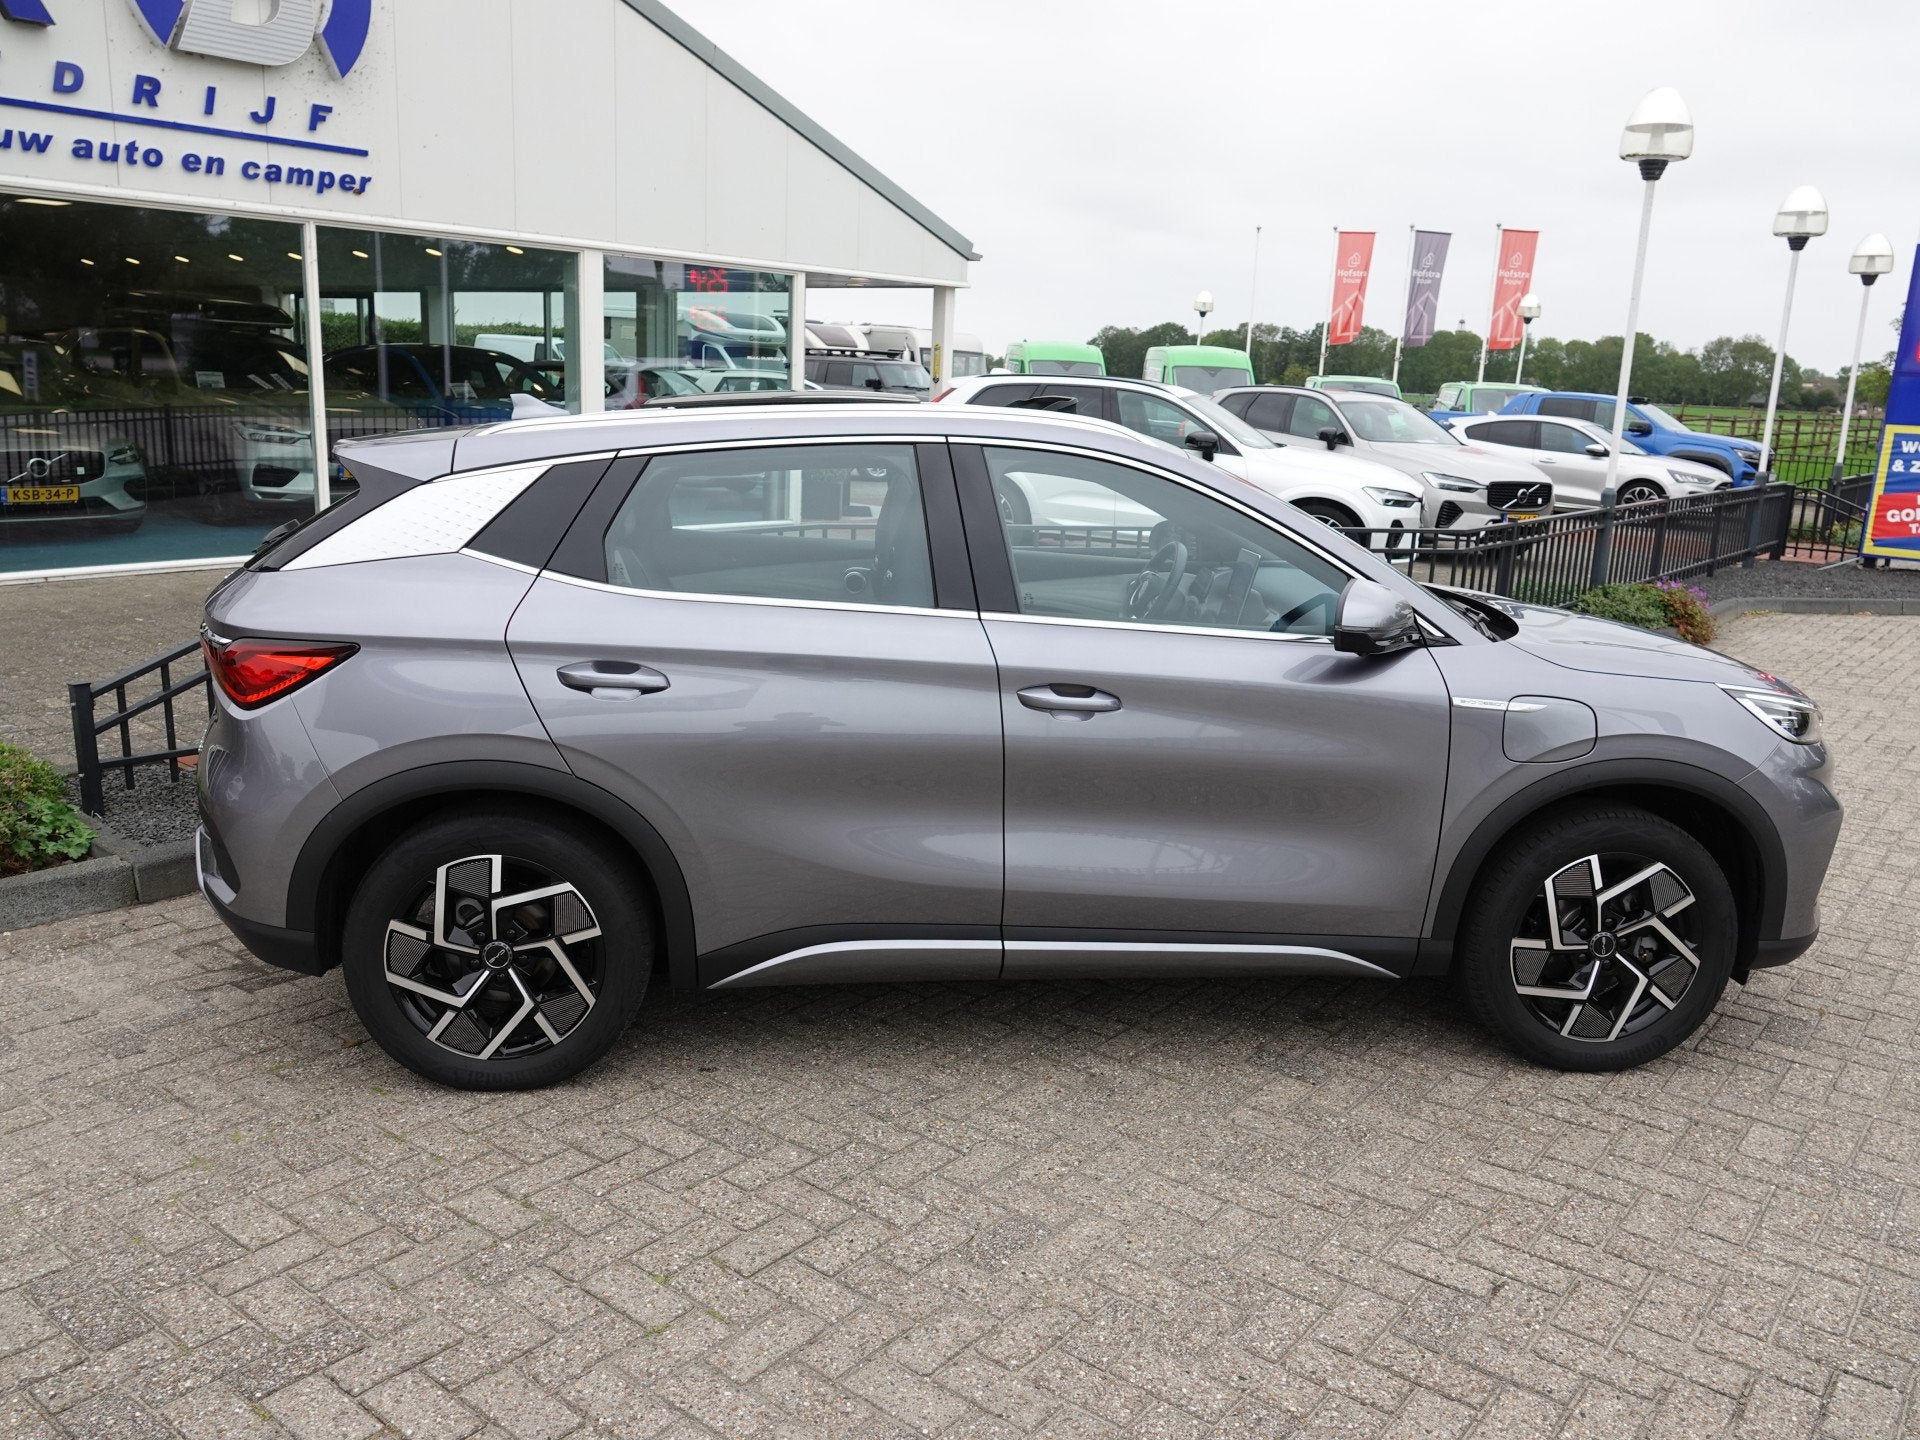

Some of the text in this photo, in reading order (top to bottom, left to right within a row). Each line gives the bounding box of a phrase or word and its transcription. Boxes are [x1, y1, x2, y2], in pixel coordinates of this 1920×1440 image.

[71, 138, 163, 168] auto
[181, 150, 225, 176] en
[241, 160, 372, 194] camper
[1337, 269, 1368, 277] Hofstra
[1412, 269, 1441, 278] Hofstra
[1499, 269, 1530, 278] Hofstra
[1891, 459, 1905, 472] &
[12, 489, 74, 500] KSB-34-P
